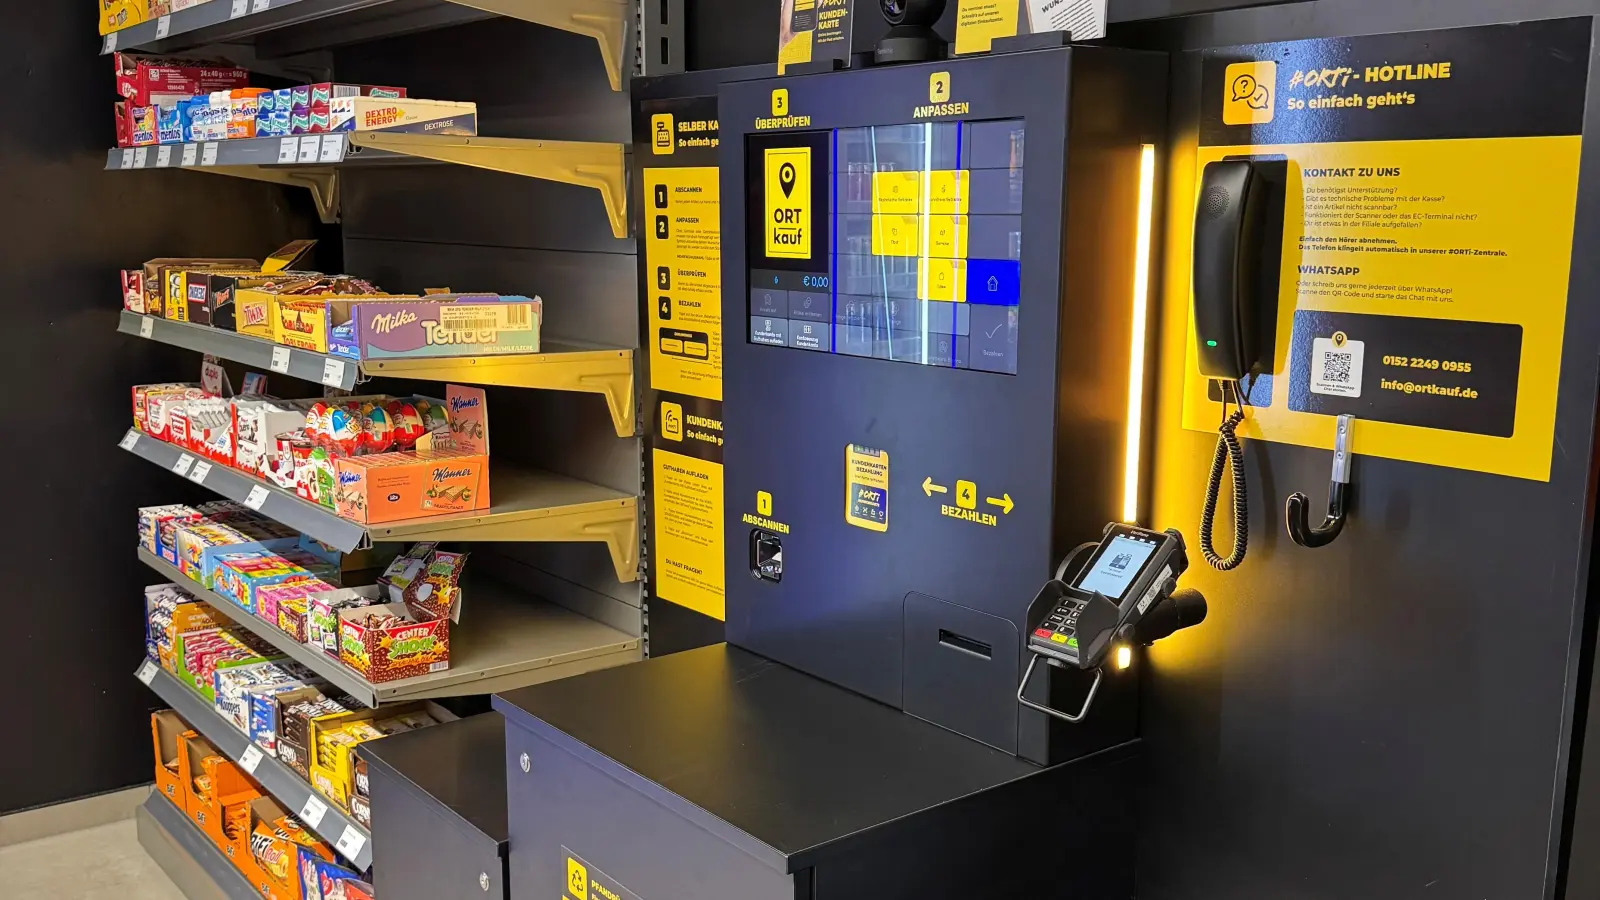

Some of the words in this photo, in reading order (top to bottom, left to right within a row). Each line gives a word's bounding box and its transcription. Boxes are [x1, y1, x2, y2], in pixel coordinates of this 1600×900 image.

[819, 8, 848, 20] KUNDEN-
[818, 19, 840, 30] KARTE
[1365, 62, 1451, 82] HOTLINE
[936, 81, 943, 93] 2
[777, 98, 782, 108] 3
[1288, 97, 1304, 110] So
[1308, 94, 1362, 108] einfach
[366, 107, 397, 118] DEXTRO
[913, 102, 969, 118] ANPASSEN
[366, 116, 397, 127] ENERGY
[424, 119, 453, 131] DEXTROSE
[678, 121, 706, 132] SELBER
[755, 115, 811, 130] ÜBERPRÜFEN
[679, 139, 686, 147] So
[688, 137, 710, 146] einfach
[1304, 168, 1355, 177] KONTAKT
[1358, 168, 1373, 176] ZU
[1376, 168, 1400, 176] UNS
[658, 192, 663, 202] 1
[774, 208, 802, 224] ORT
[659, 222, 665, 233] 2
[774, 227, 802, 244] kauf
[661, 273, 666, 284] 3
[678, 269, 706, 278] ÜBERPRÜFEN
[1298, 265, 1360, 276] WHATSAPP
[802, 276, 810, 287] €
[812, 276, 828, 287] 0,00
[1415, 286, 1452, 295] WhatsApp!
[662, 302, 668, 313] 4
[370, 309, 418, 334] Milka
[282, 335, 317, 350] TOBLERONE
[1382, 355, 1408, 366] 0152
[1410, 357, 1439, 370] 2249
[1442, 361, 1472, 373] 0955
[1381, 378, 1479, 399] info@ortkauf.de
[687, 430, 694, 438] So
[695, 431, 717, 443] einfach
[852, 459, 887, 470] KUNDENKARTEN
[432, 467, 472, 482] Manner
[663, 464, 685, 475] GUTHABEN
[686, 470, 709, 480] AUFLADEN
[856, 467, 882, 476] BEZAHLUNG
[961, 488, 970, 500] 4
[762, 499, 766, 509] 1
[942, 505, 996, 527] BEZAHLEN
[742, 513, 789, 534] ABSCANNEN
[673, 560, 683, 569] HAST
[396, 628, 430, 640] CENTER
[389, 635, 437, 658] SHOCK
